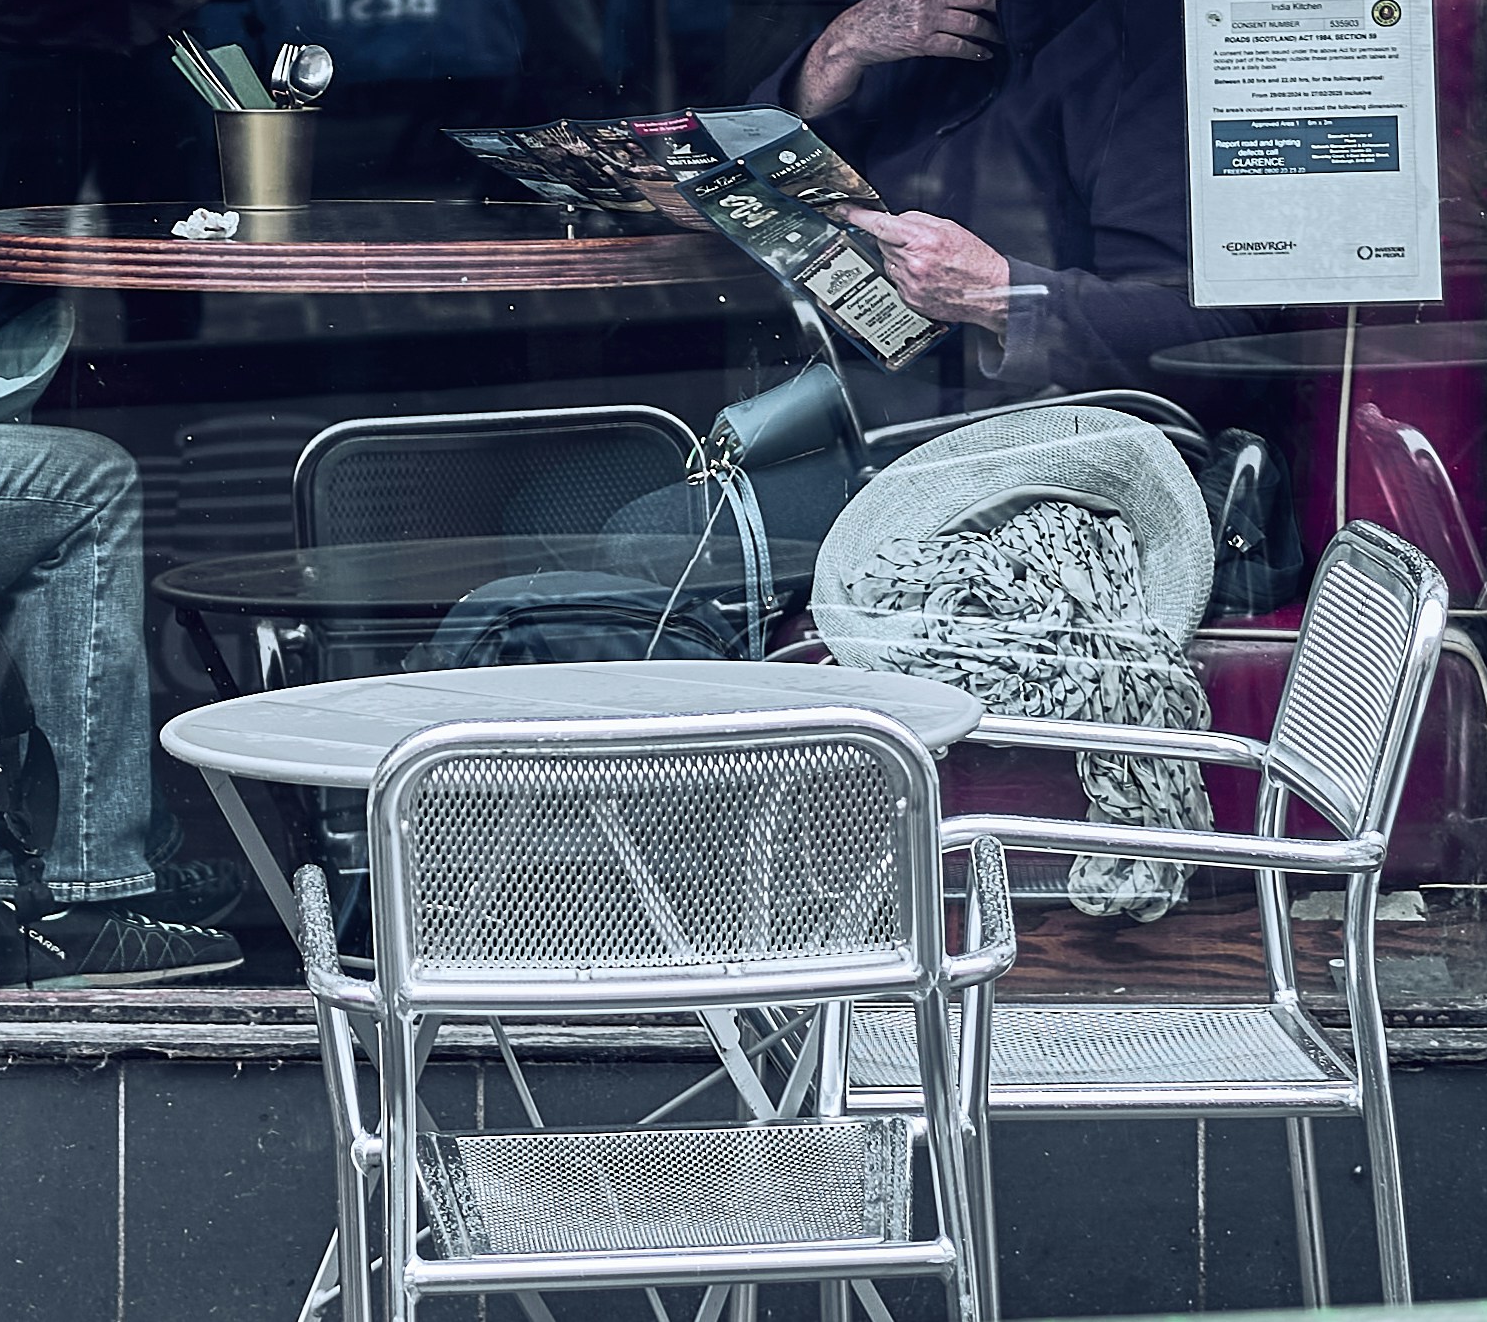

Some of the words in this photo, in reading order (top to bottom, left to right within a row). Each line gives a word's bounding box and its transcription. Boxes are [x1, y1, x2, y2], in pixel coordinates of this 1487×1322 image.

[1271, 3, 1291, 11] India
[1292, 2, 1323, 11] Kitchen
[1215, 139, 1240, 149] Report
[1259, 138, 1274, 147] and
[1275, 138, 1301, 148] lighting
[1238, 148, 1265, 157] defects
[1266, 148, 1279, 156] call
[1232, 157, 1285, 167] CLARENCE
